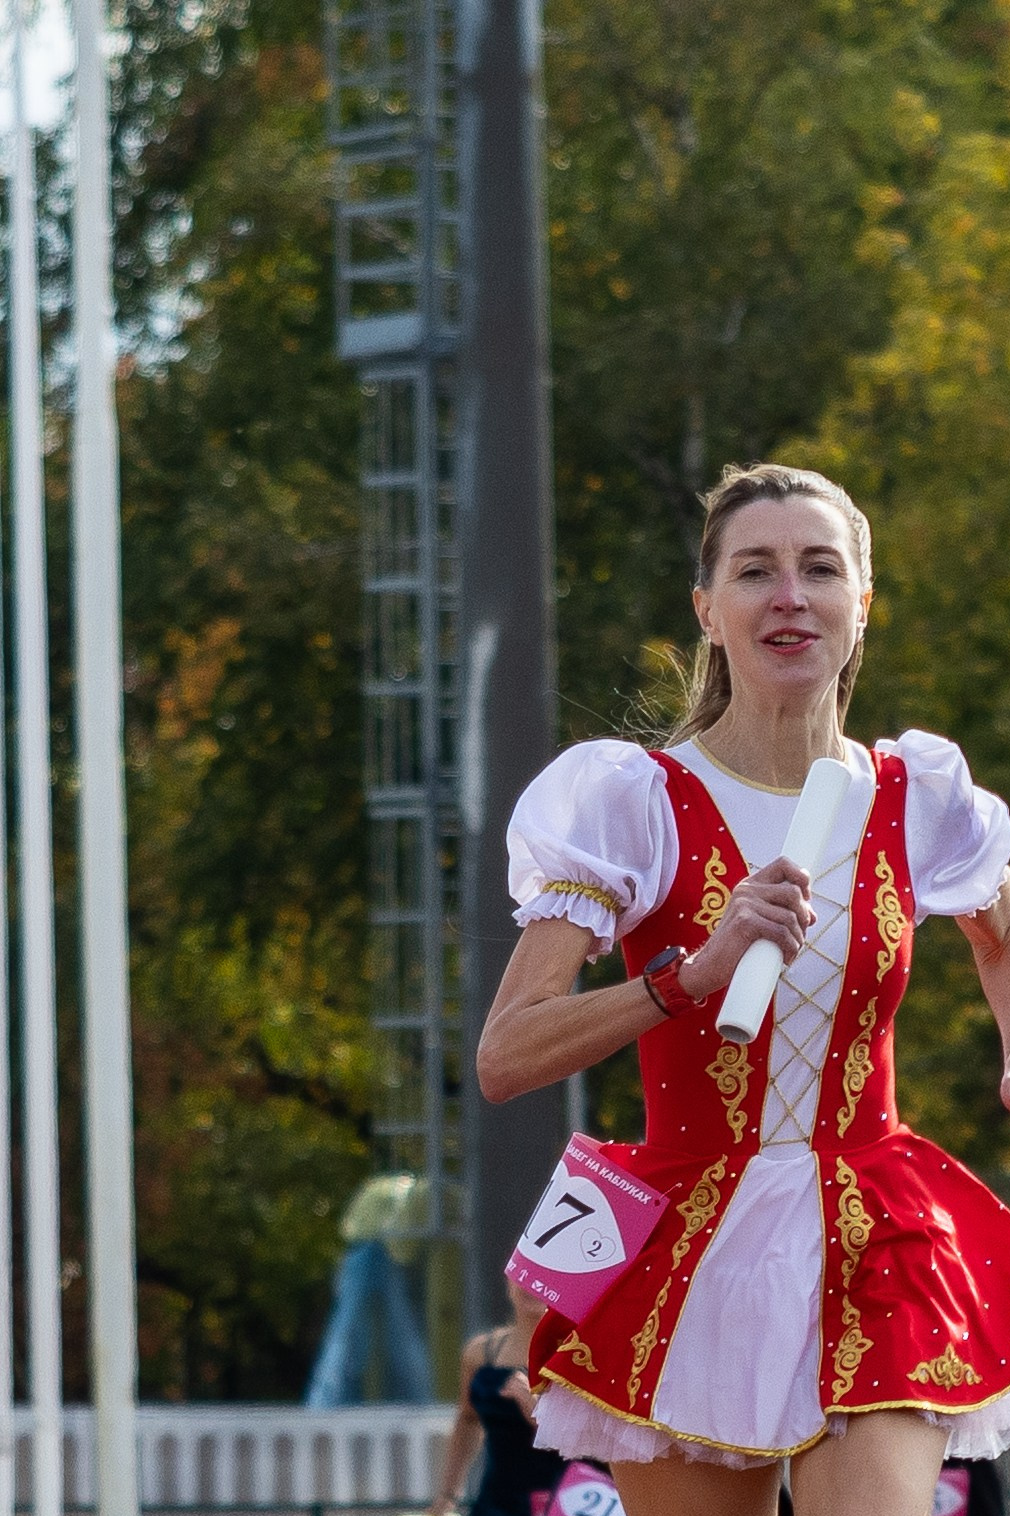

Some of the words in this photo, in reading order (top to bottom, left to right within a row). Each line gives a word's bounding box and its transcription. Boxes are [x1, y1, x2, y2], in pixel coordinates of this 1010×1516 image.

[585, 1158, 600, 1174] НА
[600, 1167, 652, 1206] КАБЛУКАХ
[586, 1240, 602, 1258] 2
